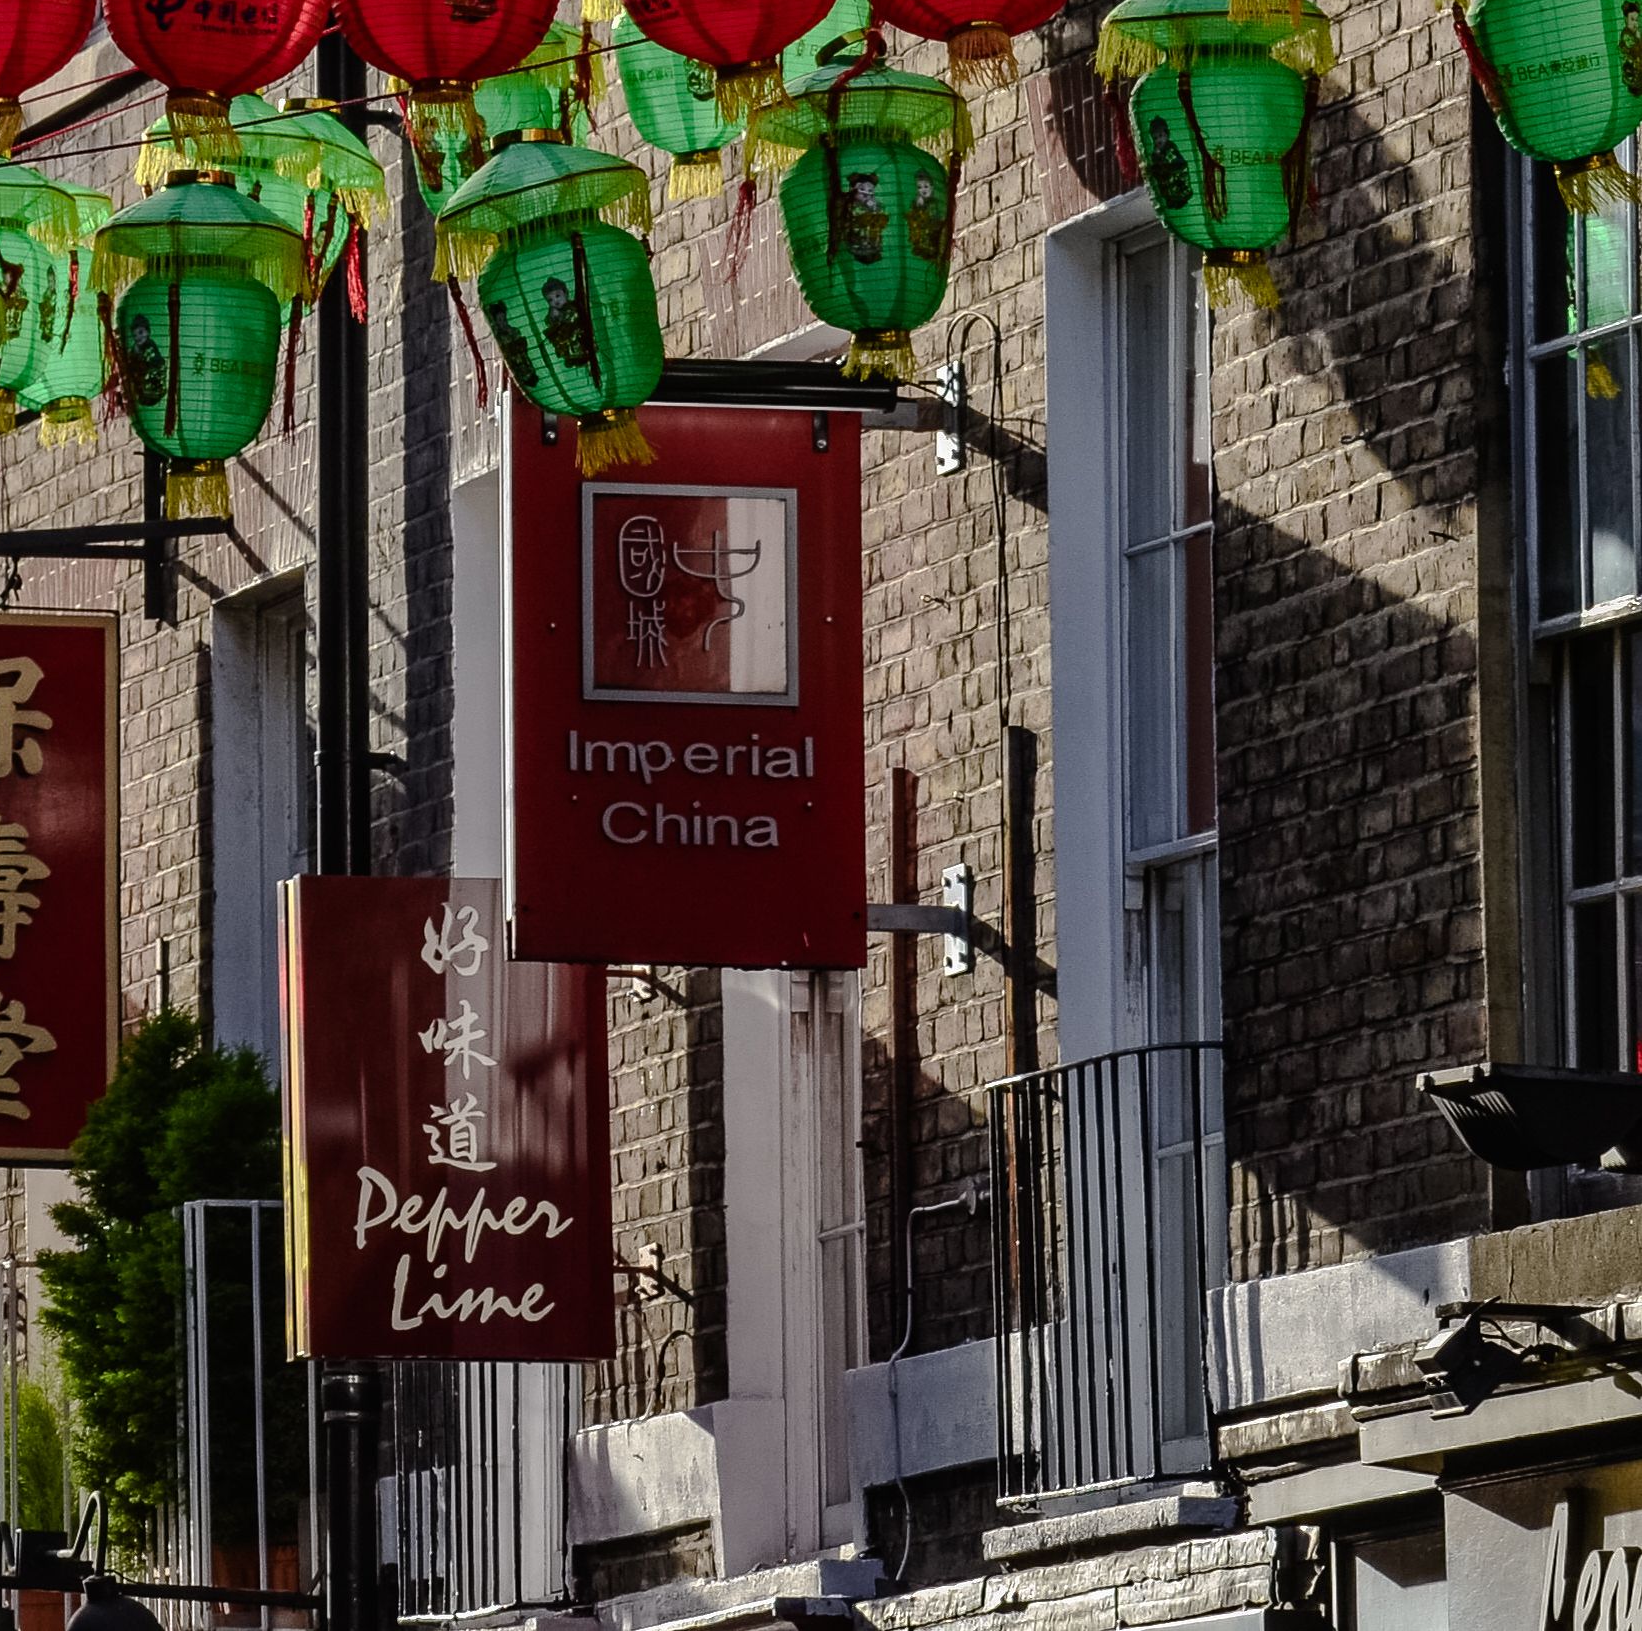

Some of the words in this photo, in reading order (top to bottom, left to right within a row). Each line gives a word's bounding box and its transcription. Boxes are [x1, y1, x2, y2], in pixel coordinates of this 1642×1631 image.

[1516, 63, 1549, 82] BEA
[1230, 149, 1259, 165] BEA
[567, 729, 815, 785] Imperial
[601, 800, 780, 849] China
[417, 902, 499, 1174] 好味道
[355, 1166, 574, 1263] Pepper
[390, 1251, 555, 1330] Lime
